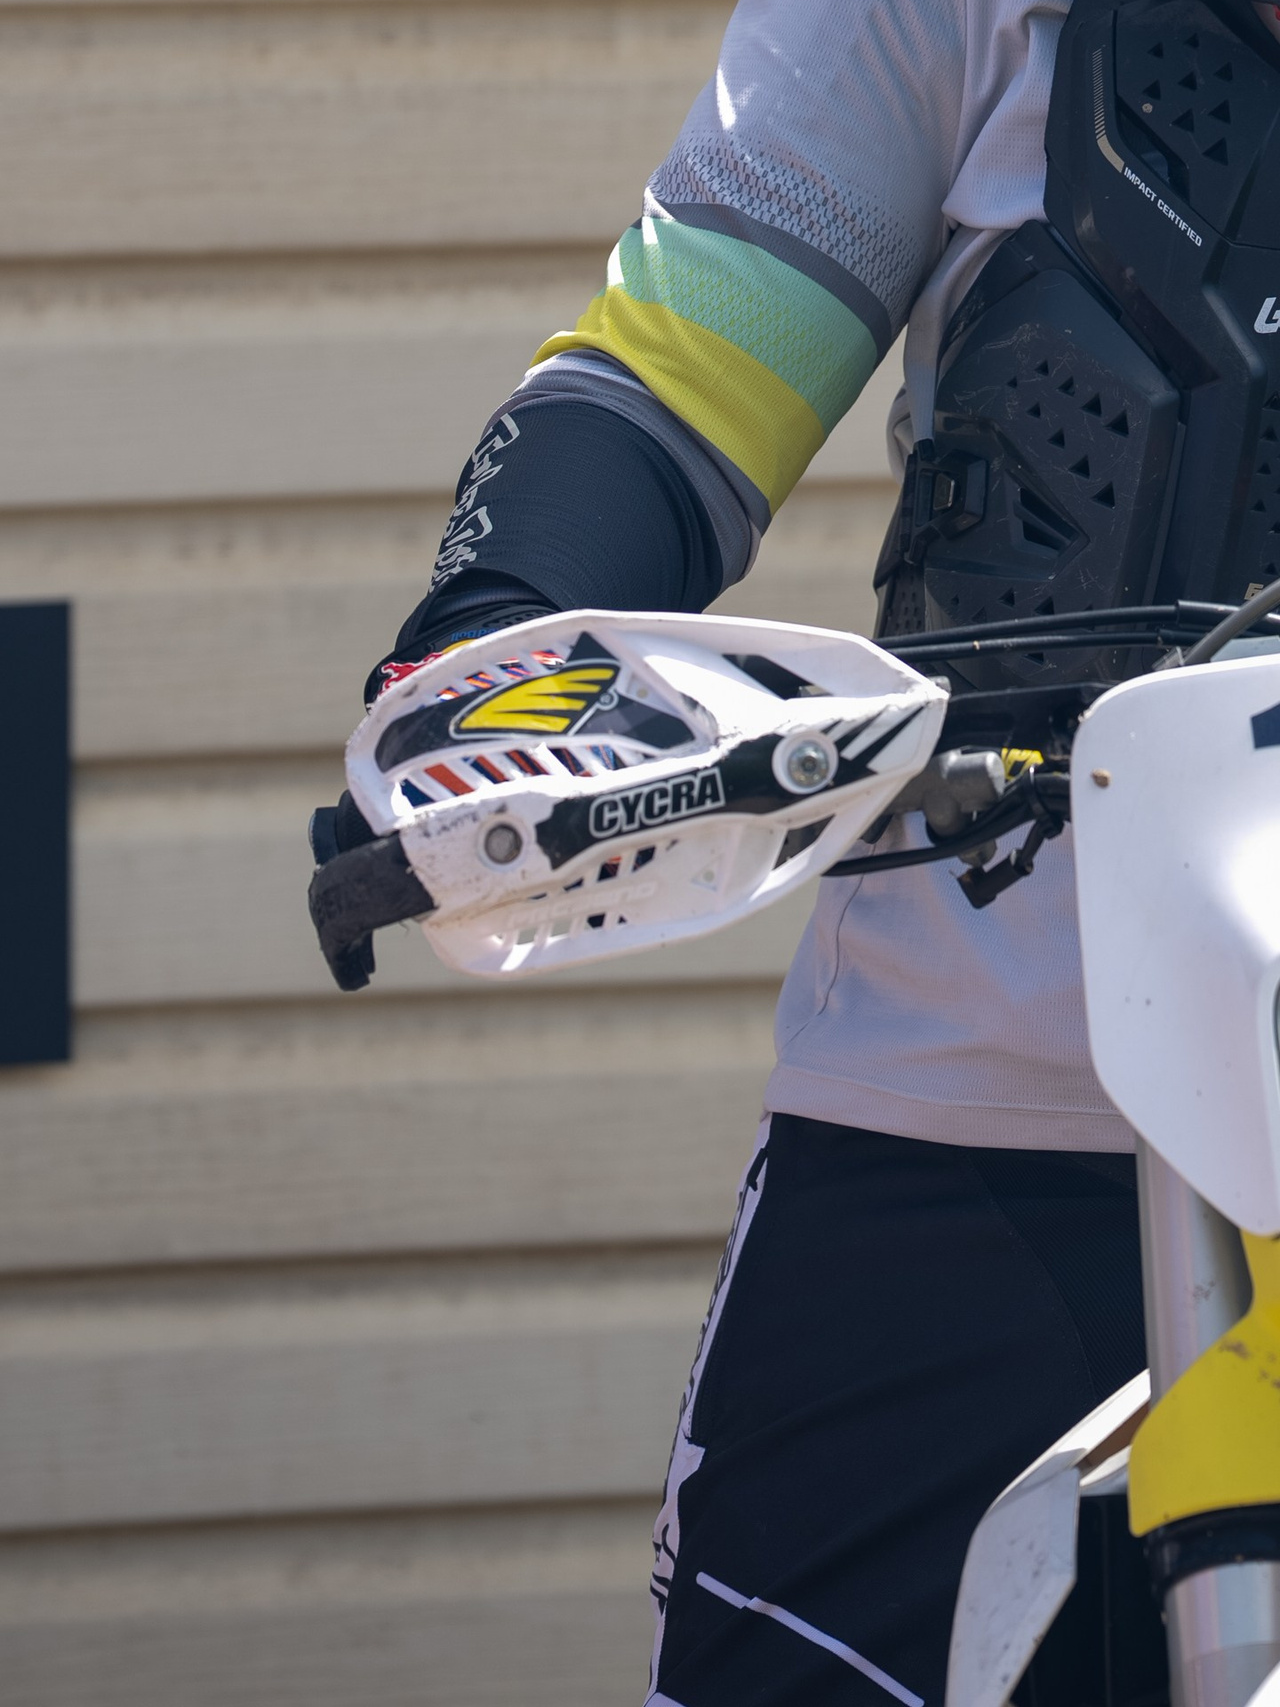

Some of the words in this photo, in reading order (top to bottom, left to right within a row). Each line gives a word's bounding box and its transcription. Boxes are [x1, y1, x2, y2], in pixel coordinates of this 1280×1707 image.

[1123, 166, 1157, 202] IMPACT
[1156, 198, 1203, 247] CERTIFIED
[588, 766, 727, 839] CYCRA
